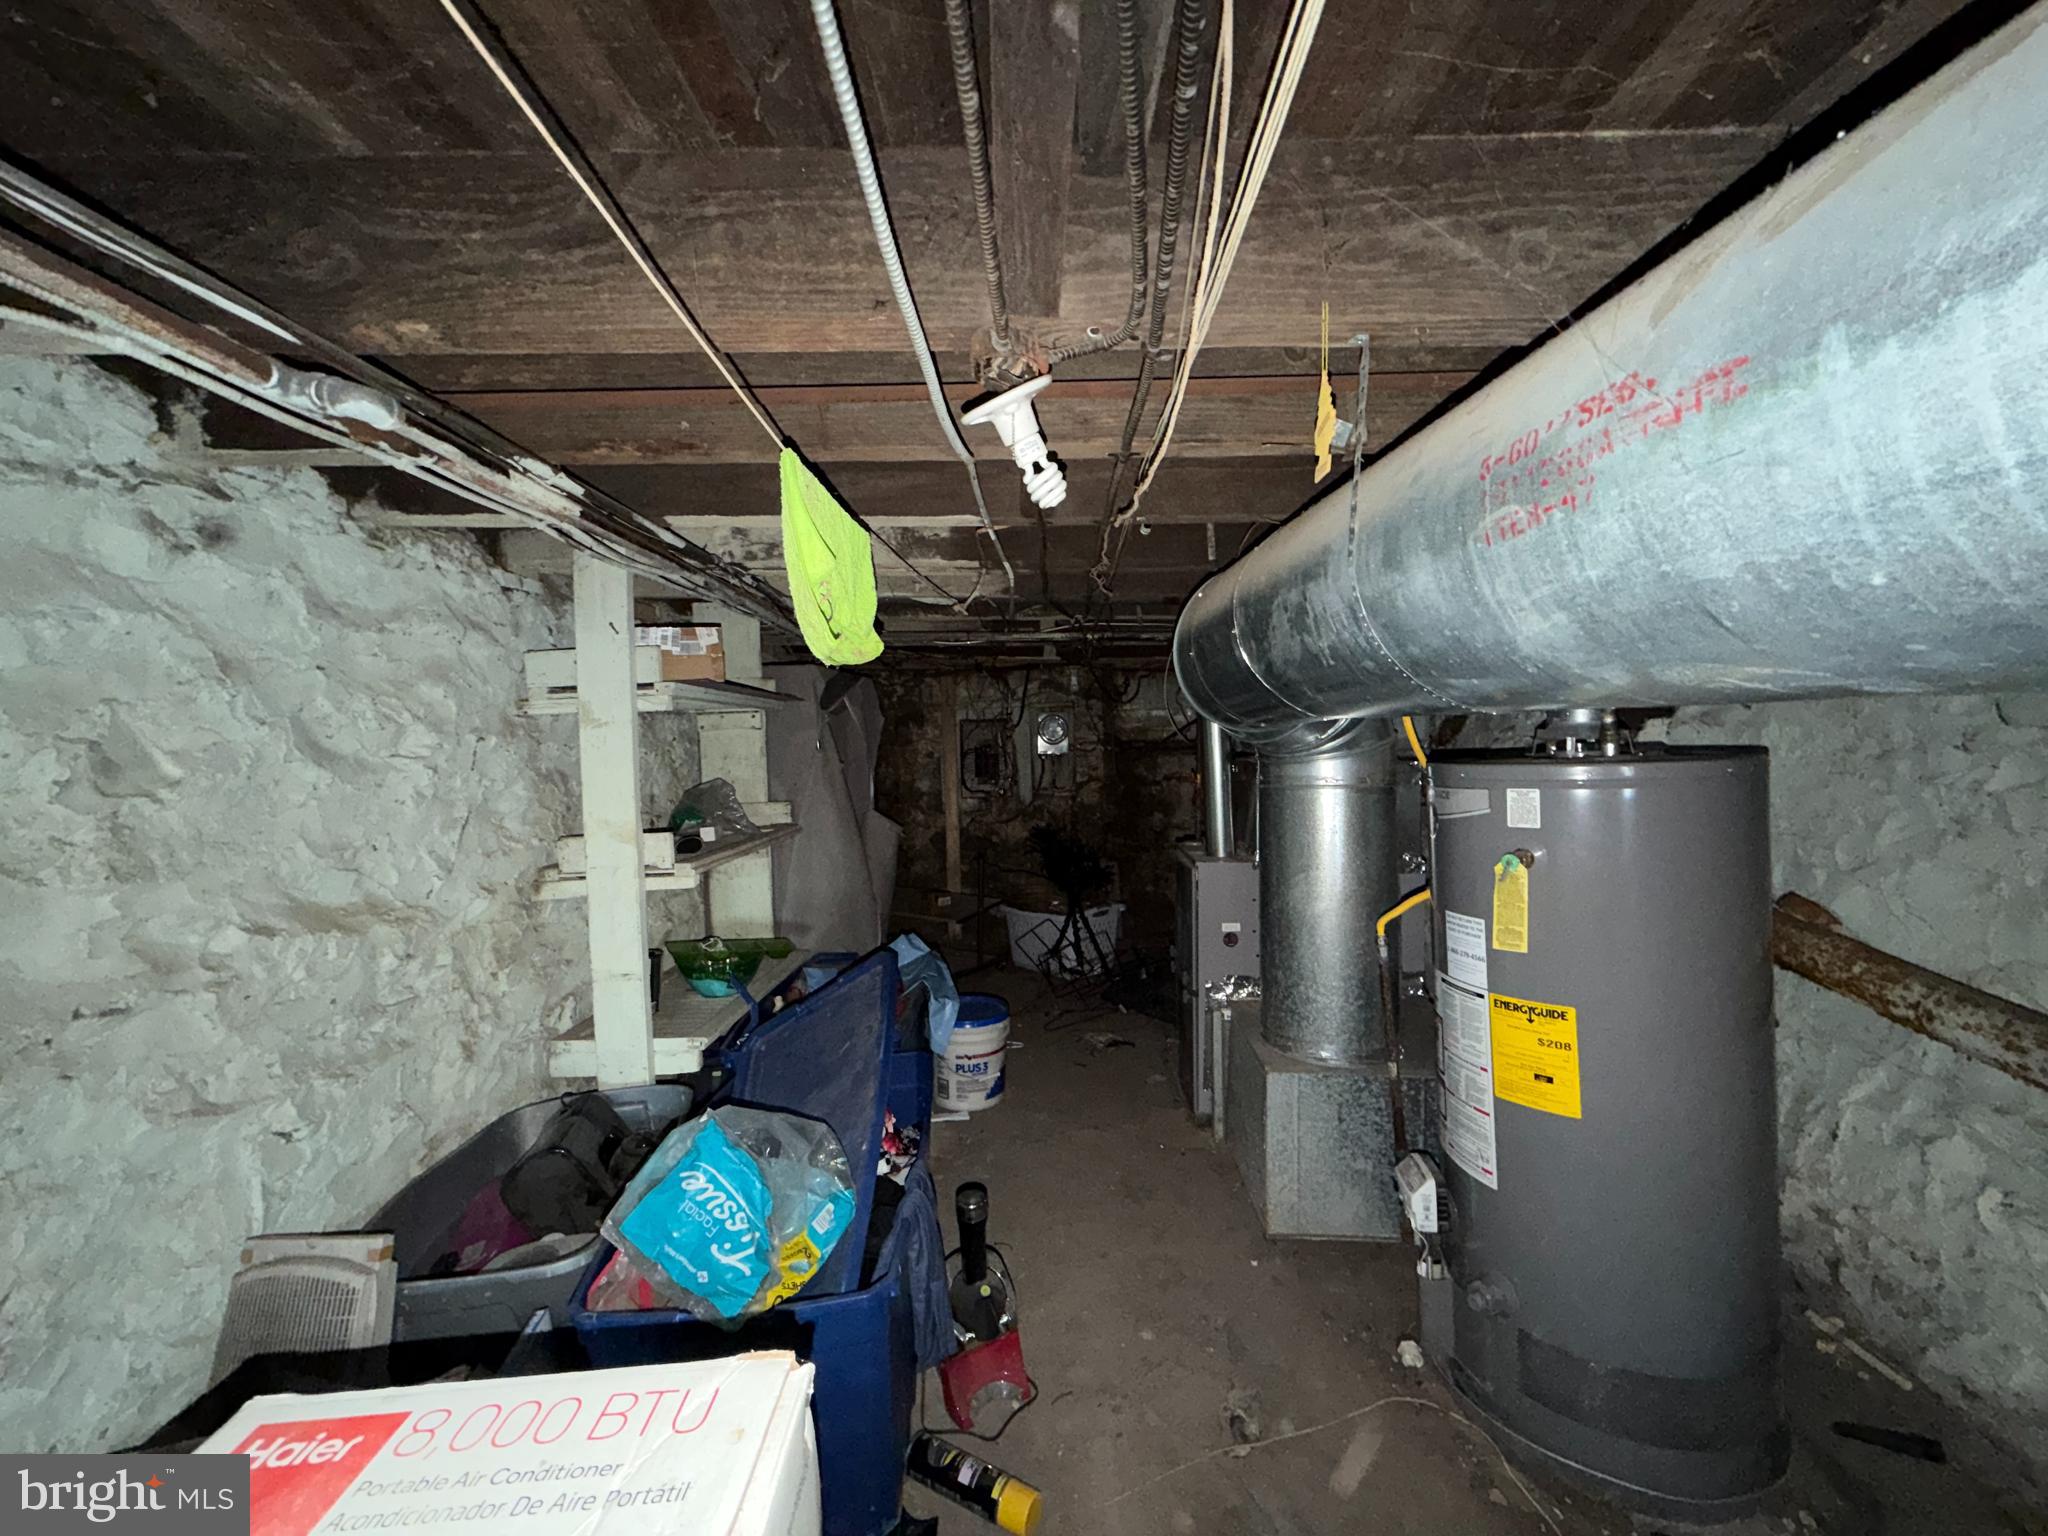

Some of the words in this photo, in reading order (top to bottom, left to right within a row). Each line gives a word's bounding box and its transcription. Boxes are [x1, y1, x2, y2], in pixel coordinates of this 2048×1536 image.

[955, 1063, 982, 1074] PLUS
[676, 1199, 719, 1238] Facial
[679, 1169, 760, 1276] Tissue
[393, 1397, 582, 1461] 8,000
[587, 1387, 720, 1441] BTU
[246, 1432, 365, 1470] Haier
[352, 1474, 449, 1498] Portable
[452, 1470, 487, 1489] Air
[489, 1461, 625, 1486] Conditioner
[323, 1499, 507, 1533] Acondicionador
[510, 1496, 546, 1518] De
[550, 1491, 598, 1513] Aire
[602, 1481, 694, 1508] Portátil
